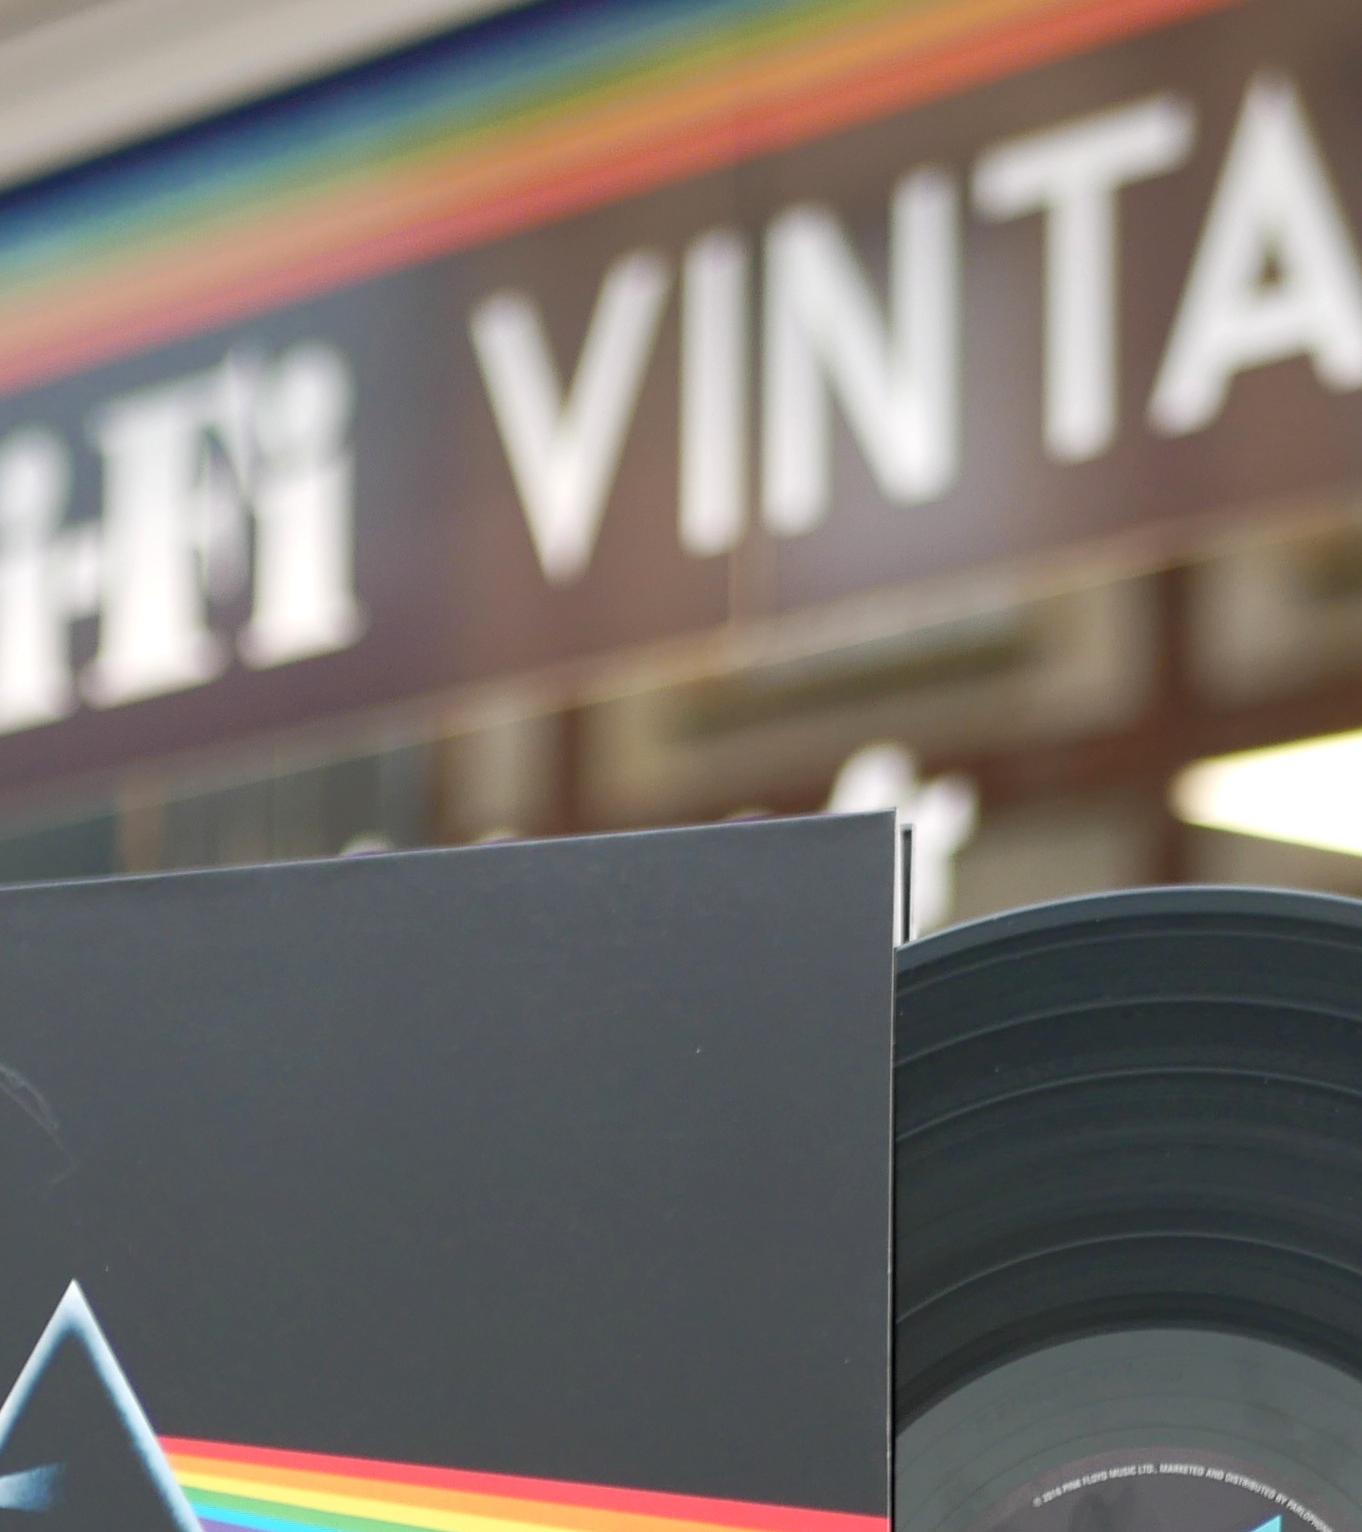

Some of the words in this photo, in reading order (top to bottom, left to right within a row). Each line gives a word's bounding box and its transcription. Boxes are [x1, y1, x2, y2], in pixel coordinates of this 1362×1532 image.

[1081, 1469, 1107, 1486] FLOYD
[1108, 1464, 1136, 1478] MUSIC
[1159, 1463, 1204, 1476] MARKETED
[1205, 1467, 1224, 1481] AND
[1224, 1472, 1276, 1500] DISTRIBUTED
[1274, 1492, 1288, 1506] BY
